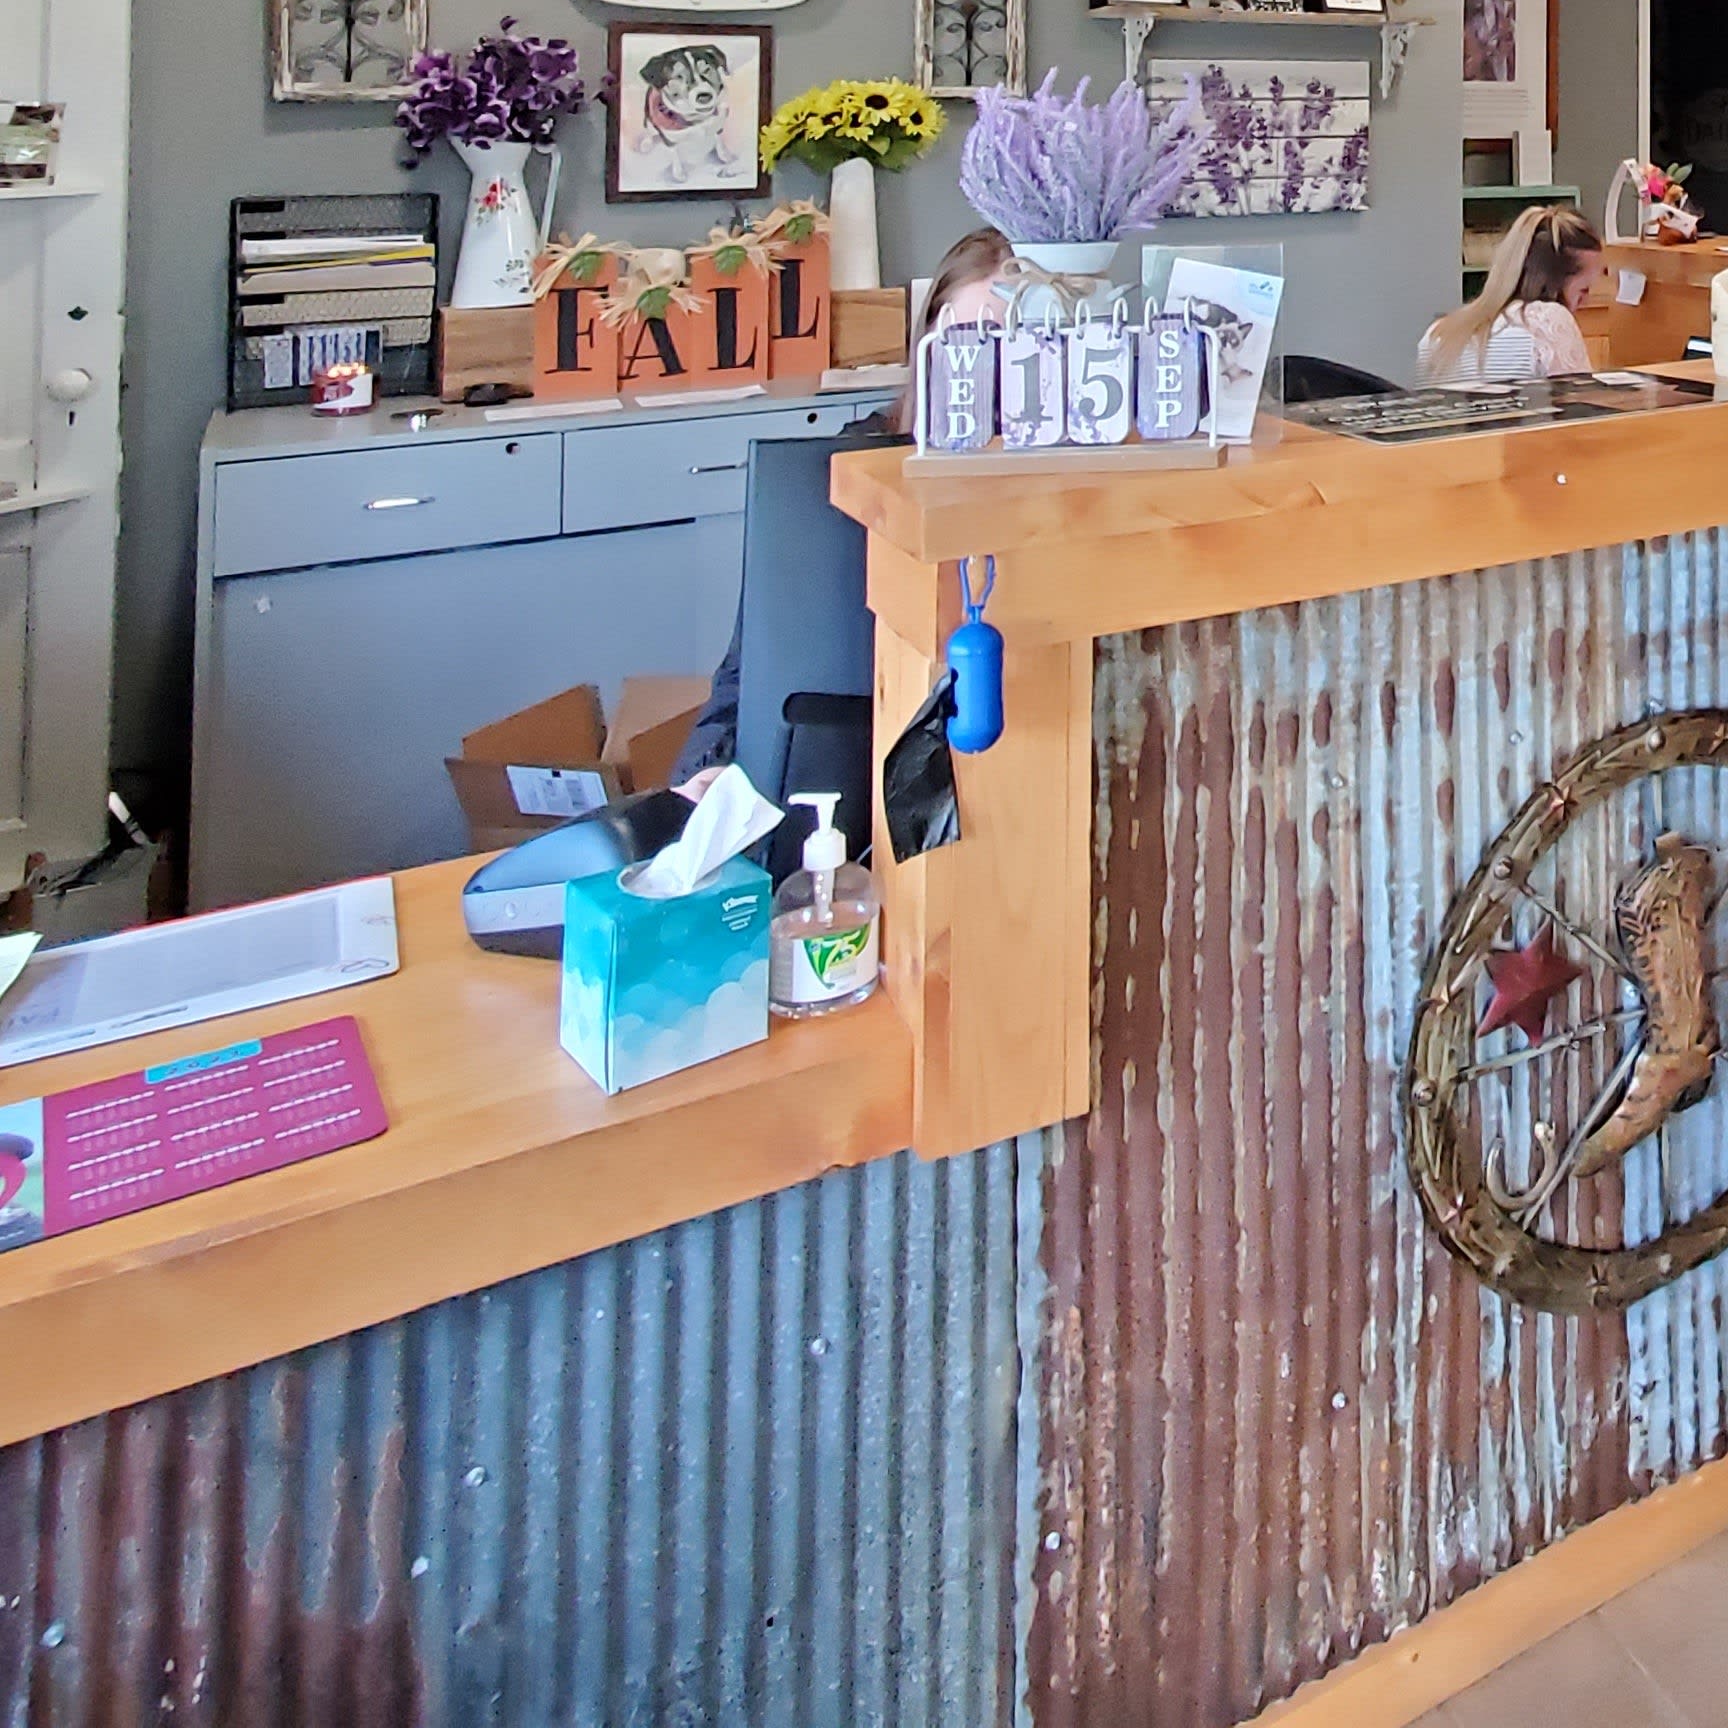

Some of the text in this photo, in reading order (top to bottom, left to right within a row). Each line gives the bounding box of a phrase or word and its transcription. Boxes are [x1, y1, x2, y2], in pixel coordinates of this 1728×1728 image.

[544, 258, 820, 380] FALL
[944, 345, 981, 440] WED
[1155, 330, 1183, 429] SEP
